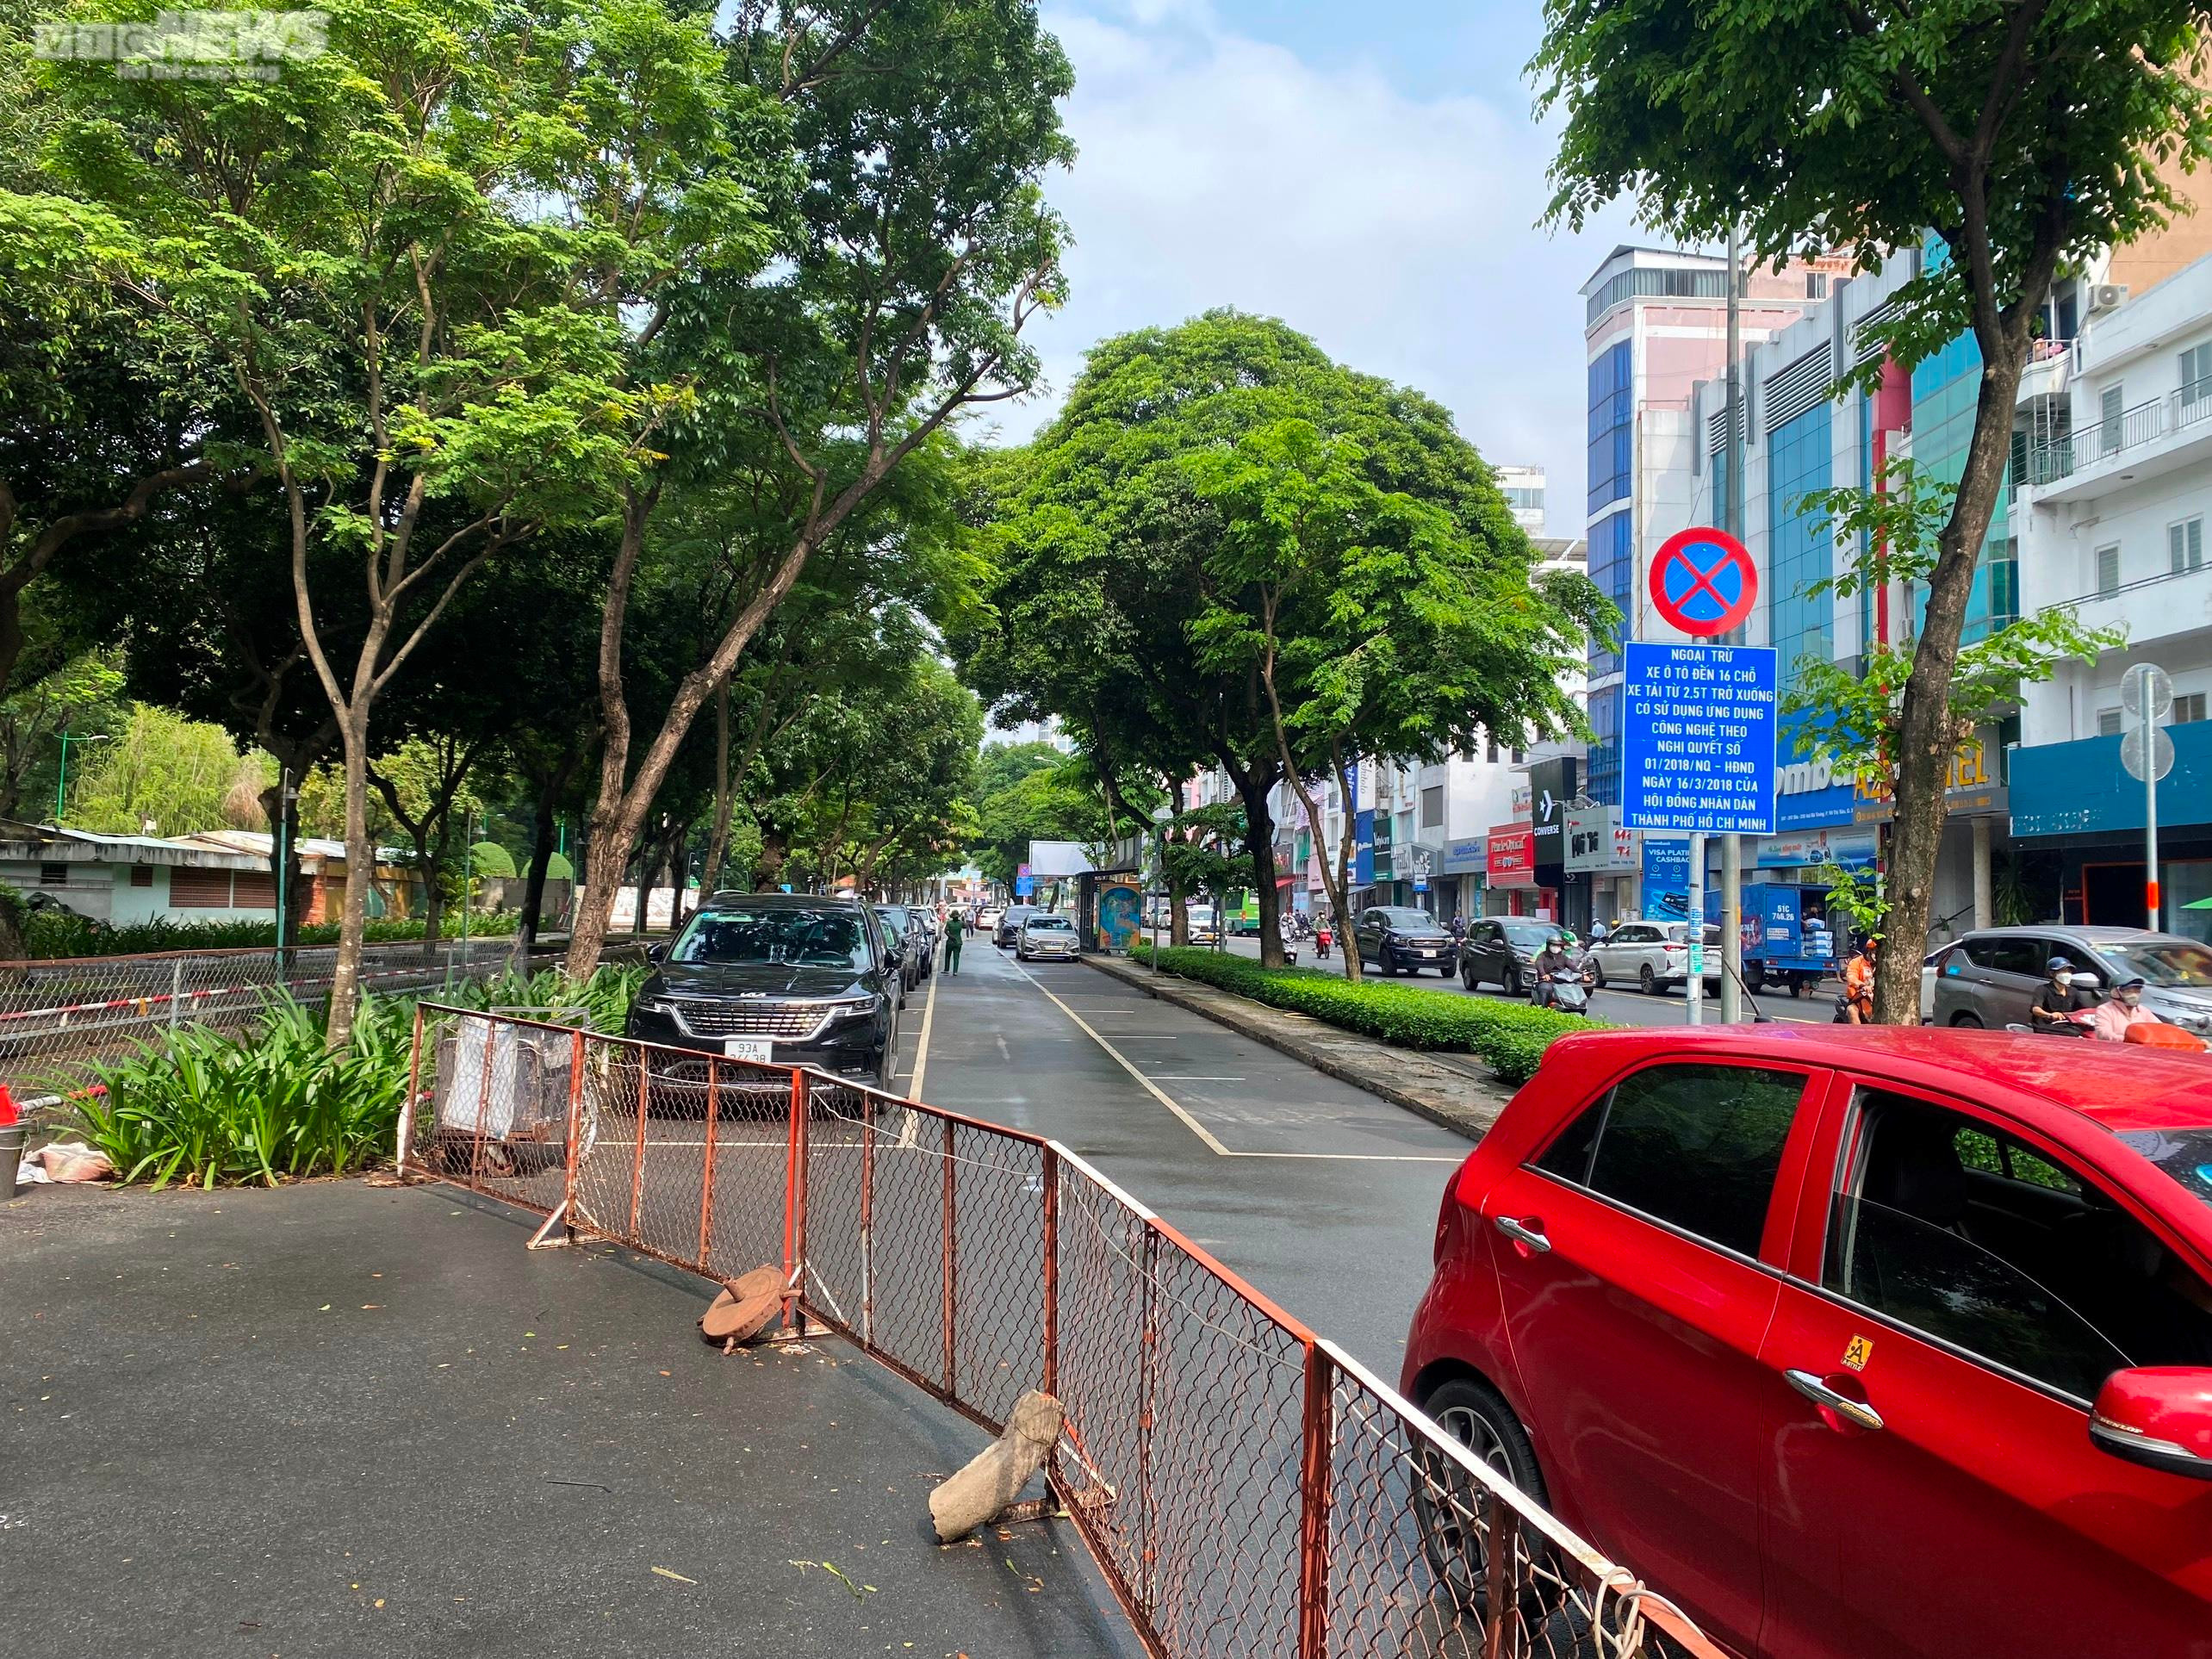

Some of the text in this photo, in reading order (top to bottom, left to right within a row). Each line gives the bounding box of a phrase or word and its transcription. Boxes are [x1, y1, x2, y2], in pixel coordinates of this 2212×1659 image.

[1672, 648, 1733, 662] NGOẠI TRỪ
[1647, 665, 1755, 682] XE Ô TÔ ĐẾN 16 CHỖ
[1628, 684, 1641, 696] XE
[1645, 682, 1662, 698] TẢI
[1666, 683, 1680, 699] TỪ
[1712, 686, 1732, 700] TRỞ
[1737, 686, 1773, 702] XUỐNG
[1636, 699, 1763, 720] CÓ SỬ DỤNG ỨNG DỤNG
[1652, 720, 1747, 738] CÔNG NGHỆ THEO
[1658, 739, 1743, 755] NGHỊ QUYẾT SỐ
[1645, 758, 1711, 772] 01/2018/NQ
[1725, 761, 1754, 774] HĐND
[1643, 775, 1757, 792] NGÀY 16/3/2018 CỦA
[1644, 793, 1755, 811] HỘI ĐỒNG NHÂN DÂN
[1632, 812, 1668, 826] THÀNH
[1673, 811, 1694, 827] PHỐ
[1699, 811, 1712, 828] HỒ
[1718, 814, 1734, 829] CHÍ
[1739, 817, 1766, 830] MINH
[1534, 824, 1559, 836] CONVERSE
[1777, 904, 1790, 913] 51C
[738, 1043, 758, 1053] 93A
